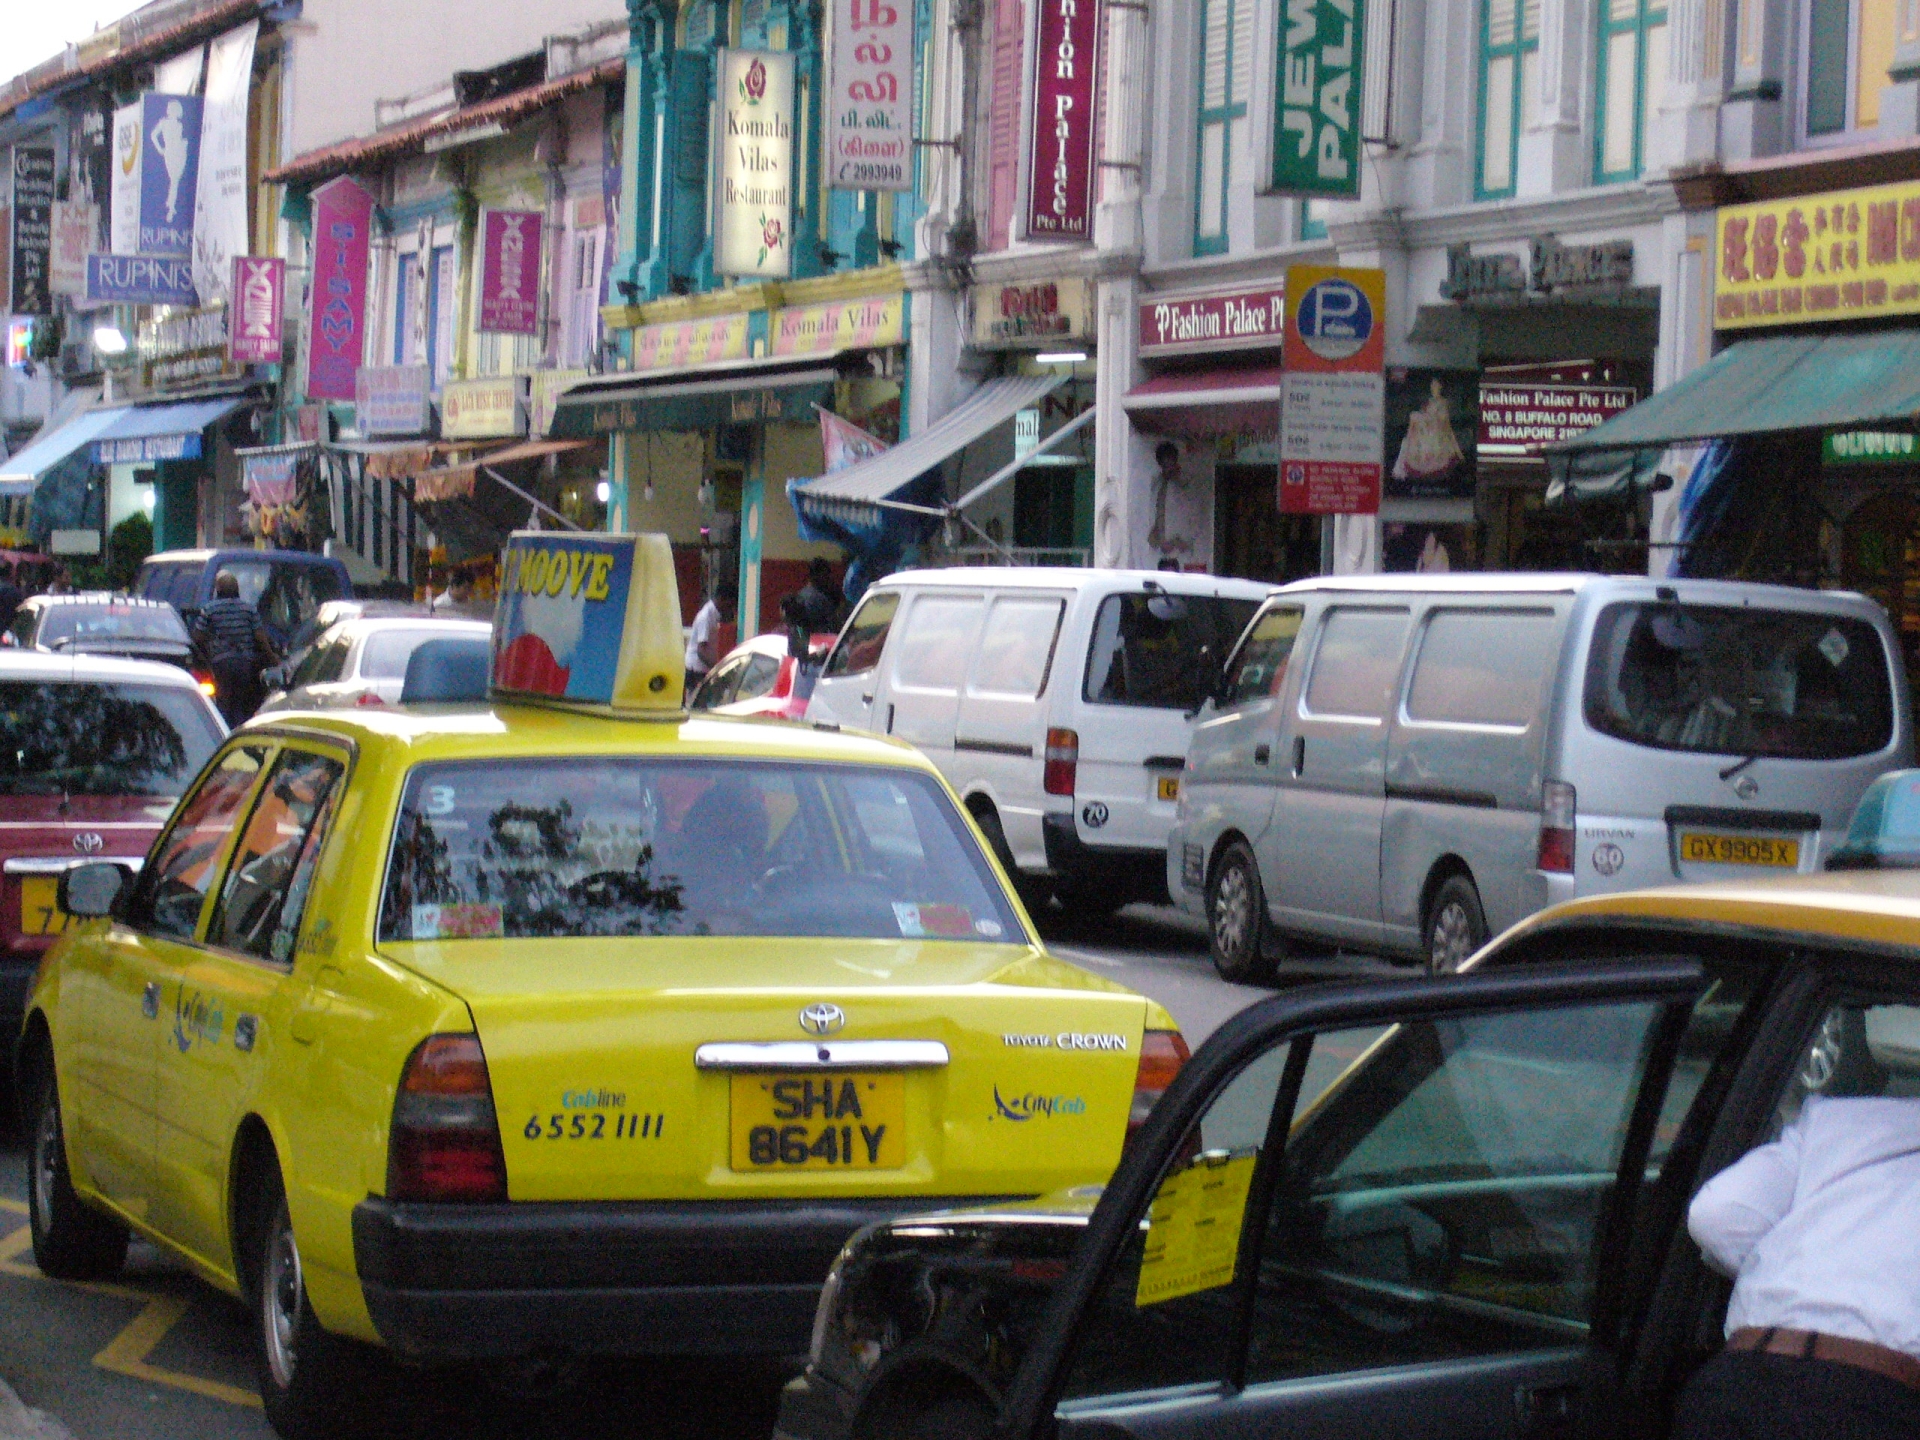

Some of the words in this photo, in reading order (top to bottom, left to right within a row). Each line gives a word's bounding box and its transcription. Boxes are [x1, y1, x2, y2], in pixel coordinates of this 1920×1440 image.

[728, 110, 789, 138] Komala
[739, 146, 778, 171] Vilas
[725, 177, 786, 206] Restaurant
[781, 310, 839, 337] Komala
[848, 305, 889, 329] Vilas
[1170, 303, 1220, 341] Fashion
[1224, 298, 1266, 335] Palace
[1479, 390, 1529, 406] Fashion
[1533, 391, 1575, 407] Palace
[1578, 392, 1600, 408] Pte
[1604, 393, 1627, 409] Ltd
[1489, 426, 1556, 439] SINGAPORE
[1515, 411, 1567, 425] BUFFALO
[1569, 412, 1603, 426] ROAD
[1002, 1033, 1051, 1047] TOYOTA
[1056, 1031, 1127, 1051] CROWN
[772, 1078, 863, 1120] SHA
[749, 1123, 886, 1165] 8641Y
